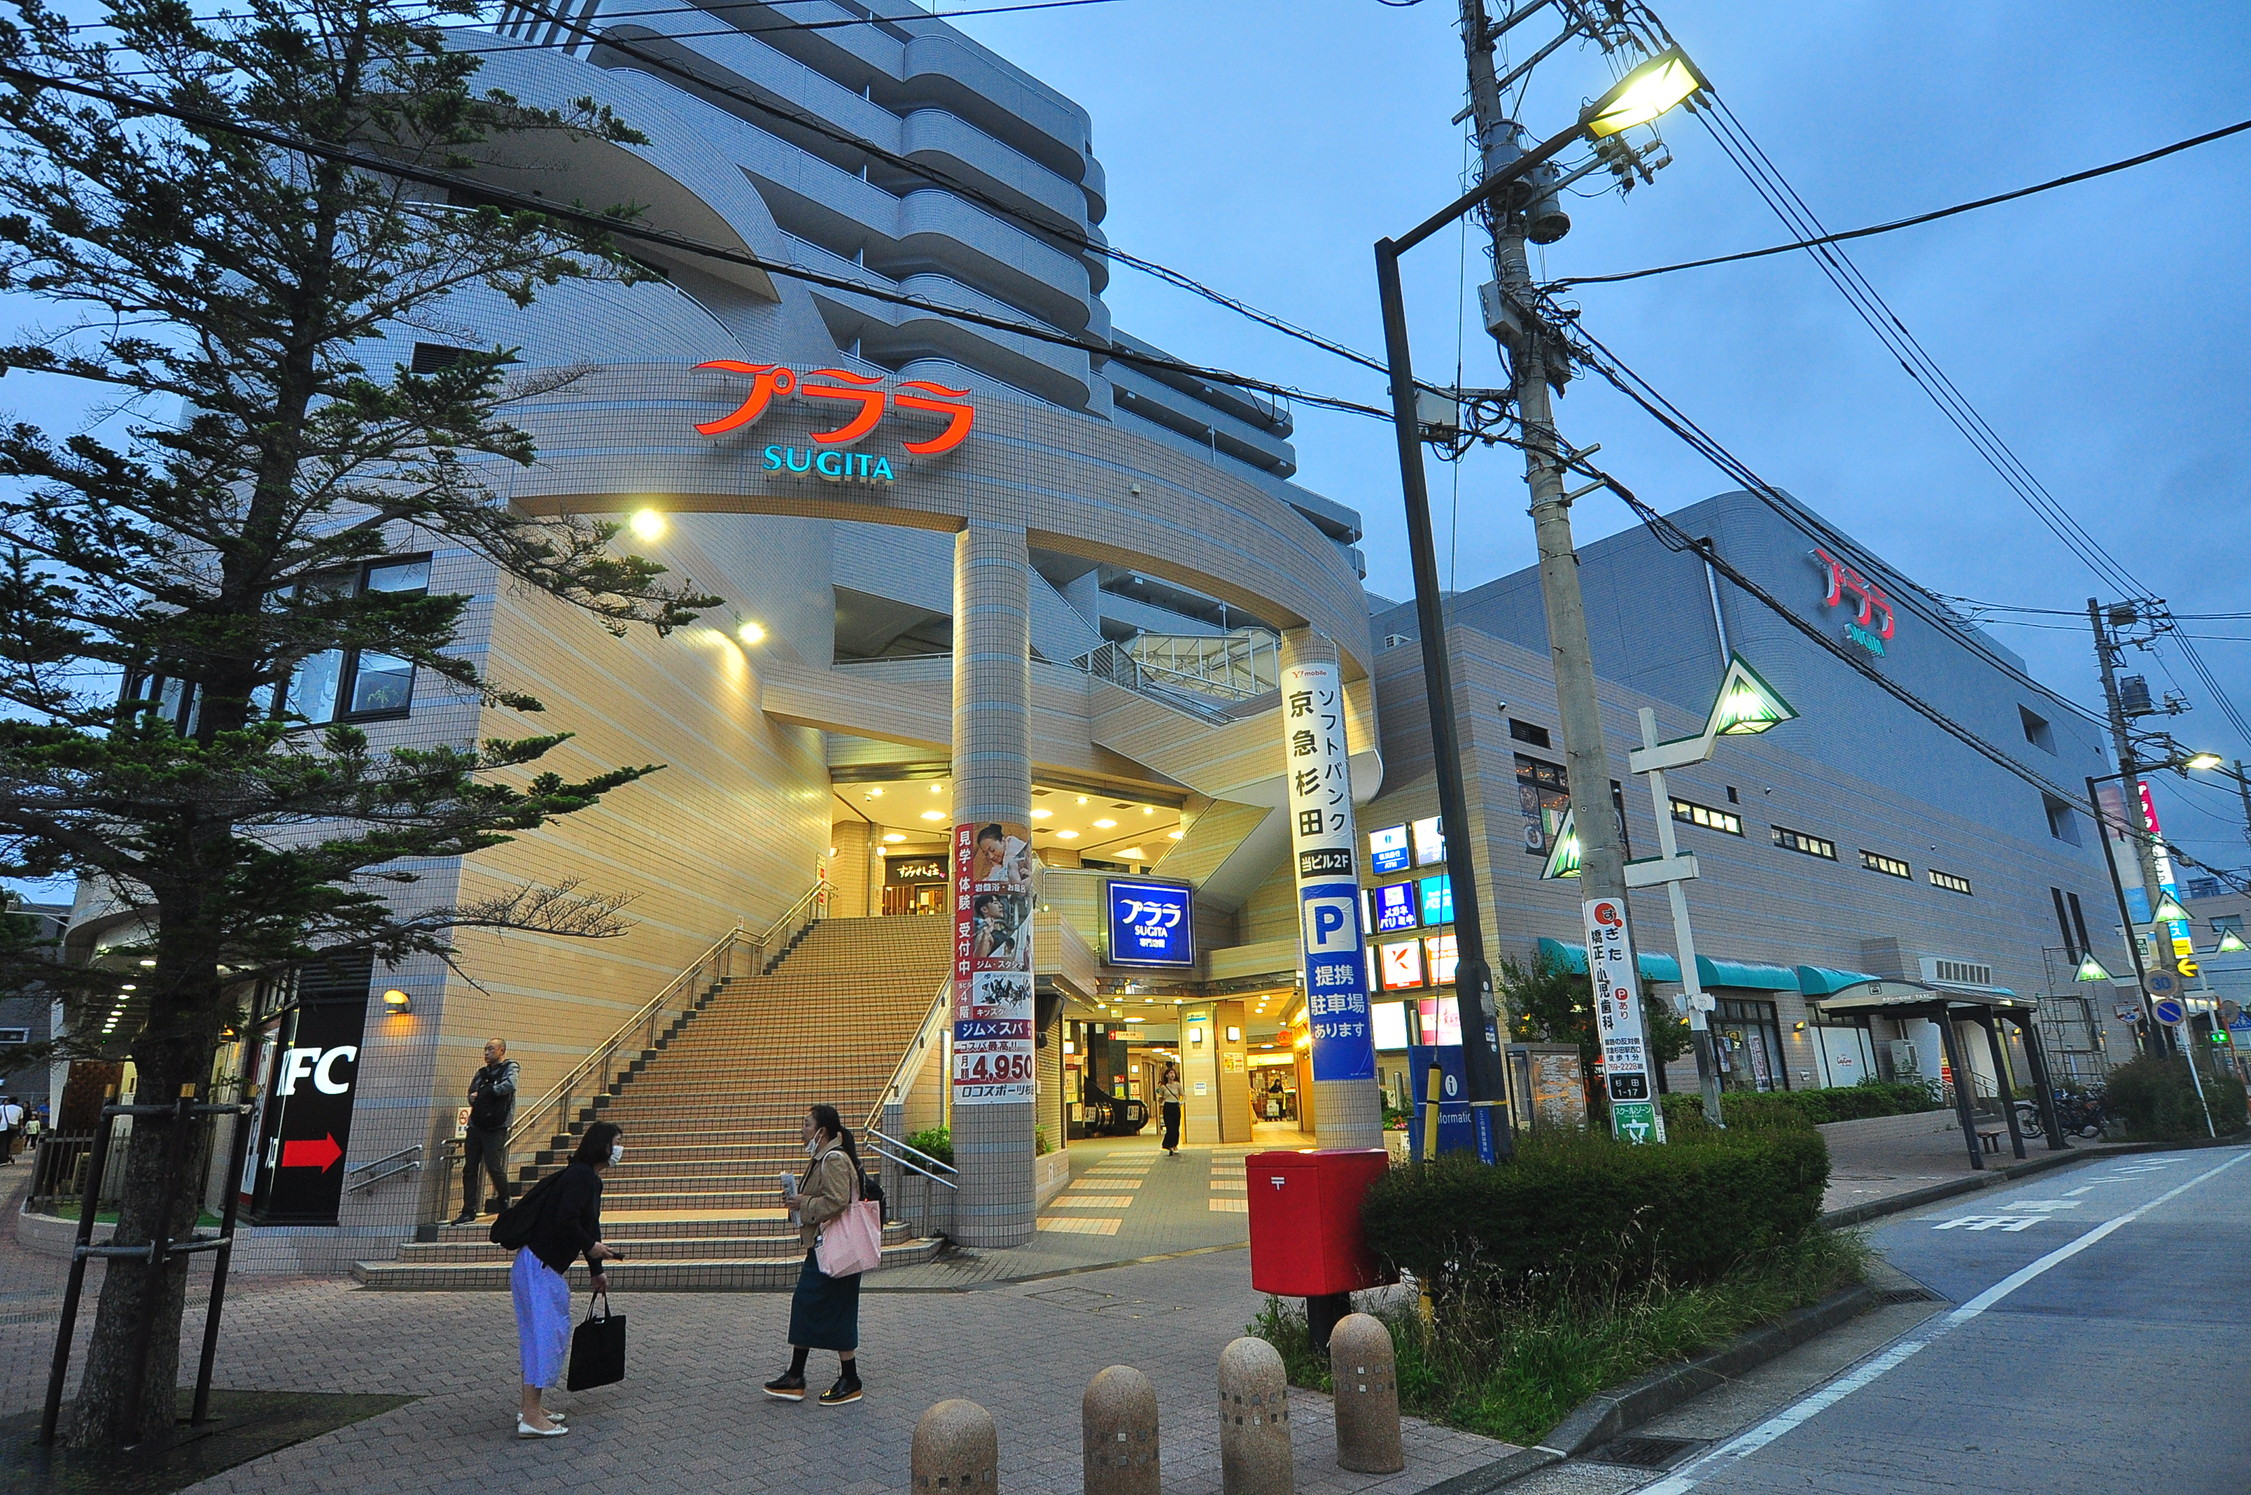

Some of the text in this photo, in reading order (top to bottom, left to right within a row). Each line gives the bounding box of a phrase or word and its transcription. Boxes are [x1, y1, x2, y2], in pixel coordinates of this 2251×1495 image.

[690, 359, 975, 455] プララ
[762, 444, 895, 481] SUGITA
[1810, 548, 1895, 640] プララ
[1288, 690, 1324, 838] 京急杉田
[1318, 690, 1345, 831] ソフトバンク
[896, 862, 941, 879] すみれ荘
[1301, 854, 1349, 872] 当ビル2F
[958, 830, 972, 975] 見学・体験 受付中
[1120, 898, 1182, 928] プララ
[1134, 925, 1169, 938] SUGITA
[1314, 905, 1345, 946] P
[1314, 964, 1355, 987] 提携
[2152, 976, 2172, 990] 30
[1310, 993, 1365, 1016] 駐車場
[1314, 1022, 1365, 1039] あります
[960, 1054, 1033, 1082] 月額 4,950
[1615, 1079, 1640, 1087] 杉田
[1617, 1088, 1639, 1097] 1-17
[1615, 1106, 1652, 1115] スクールゾーン
